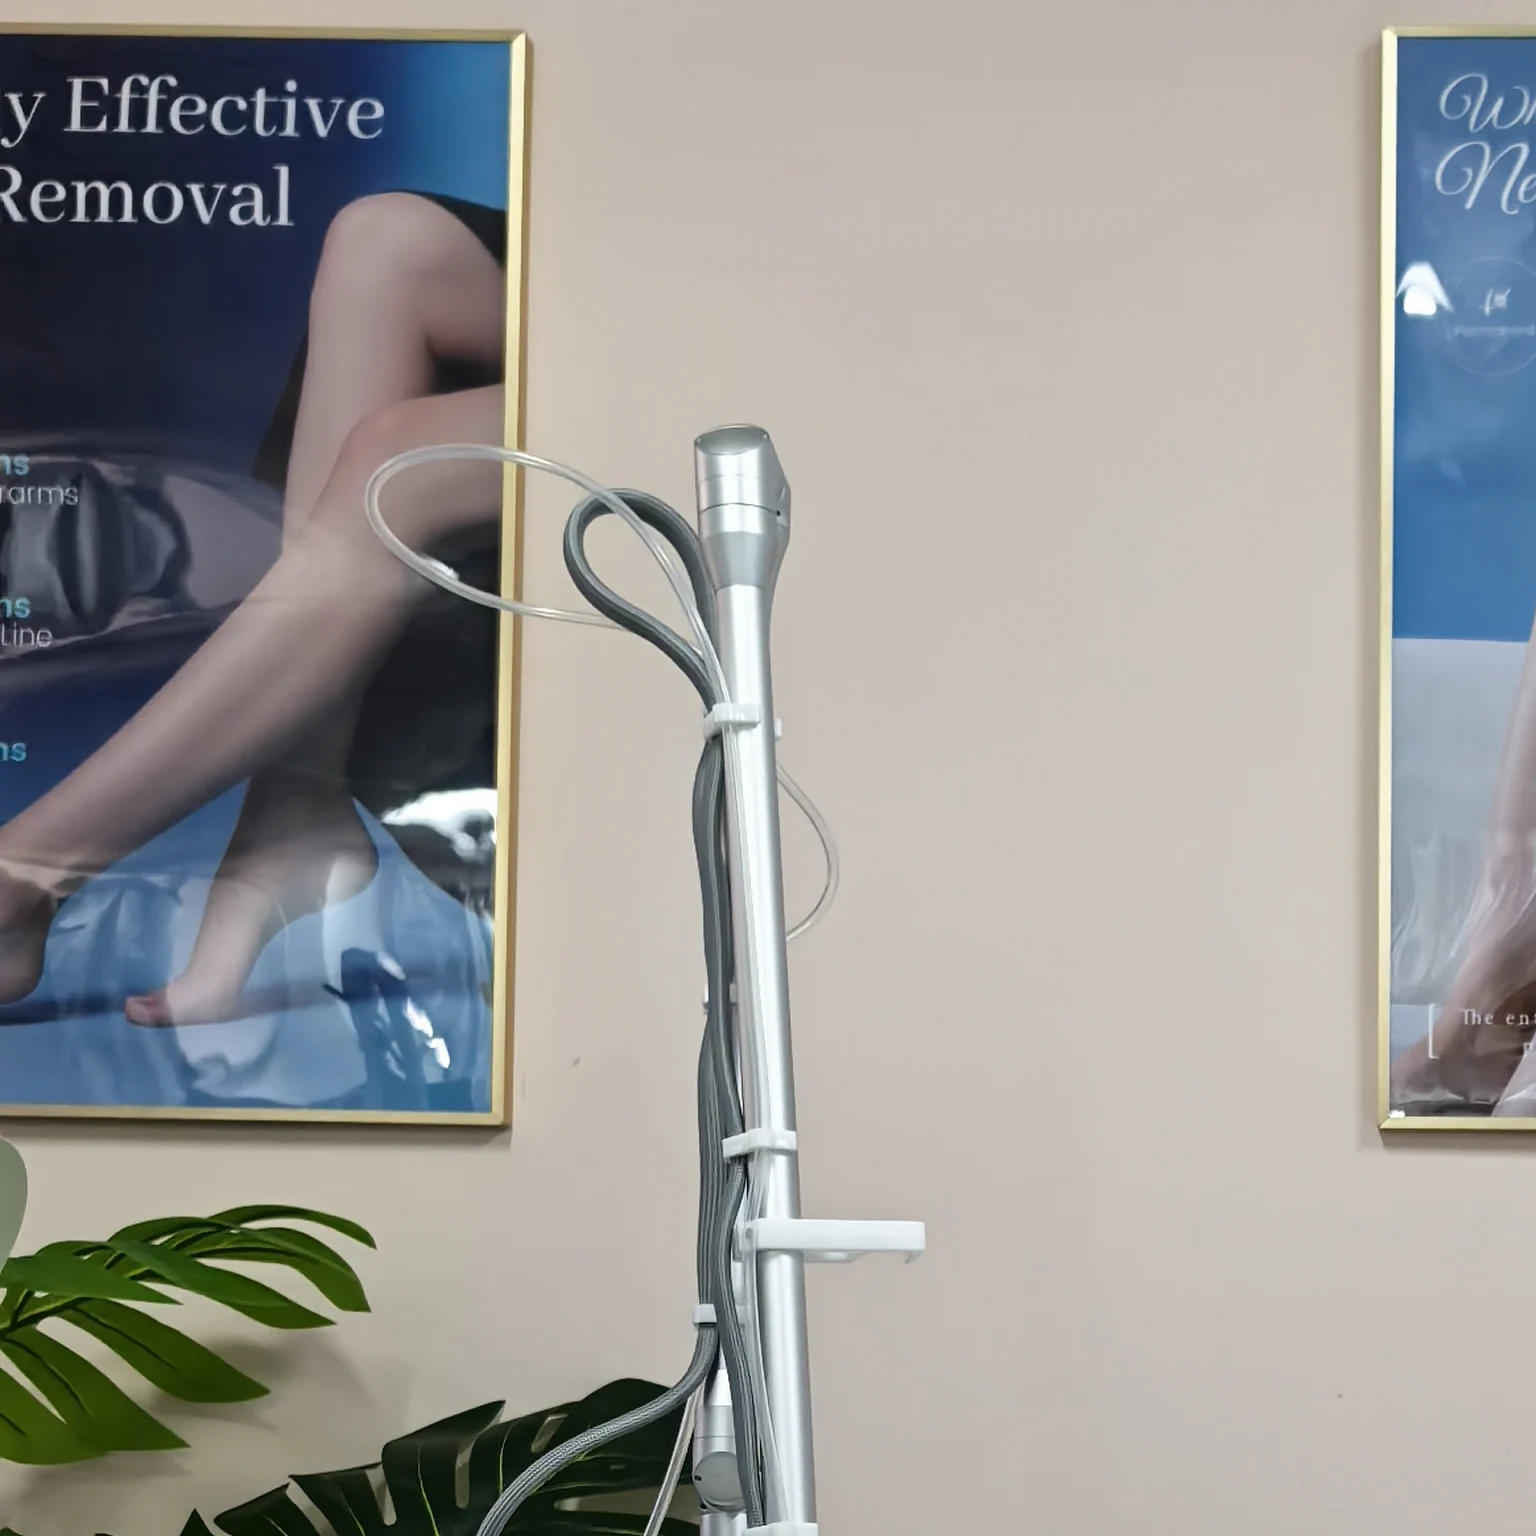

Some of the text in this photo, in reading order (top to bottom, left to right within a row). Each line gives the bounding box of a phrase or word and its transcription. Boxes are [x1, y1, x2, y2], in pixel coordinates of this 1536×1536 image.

[63, 73, 386, 141] Effective
[0, 164, 295, 228] Removal
[1461, 1008, 1494, 1026] The
